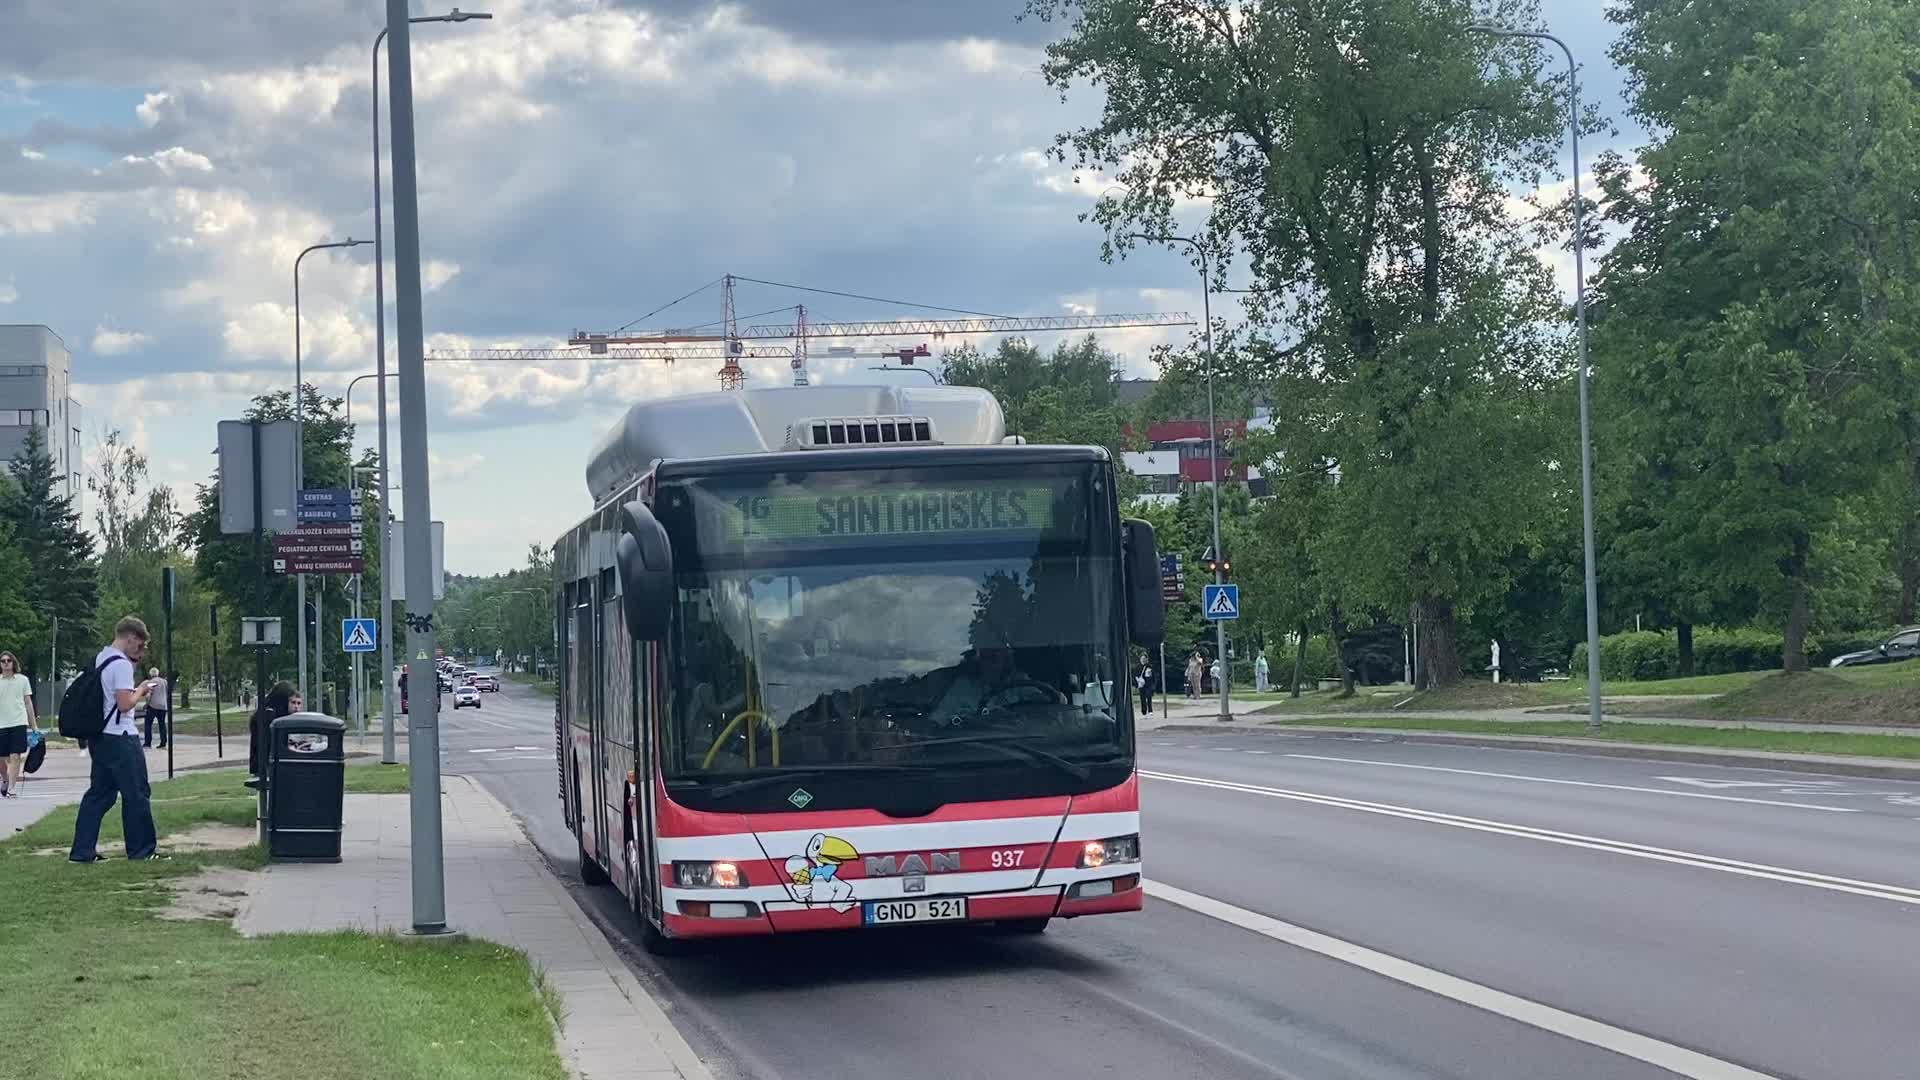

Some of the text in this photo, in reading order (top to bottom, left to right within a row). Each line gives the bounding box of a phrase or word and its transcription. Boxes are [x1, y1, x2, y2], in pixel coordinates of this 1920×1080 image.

[315, 562, 353, 570] CHIRURGIJA
[864, 851, 961, 877] MAN
[991, 850, 1025, 868] 937
[876, 900, 962, 921] GND 521
